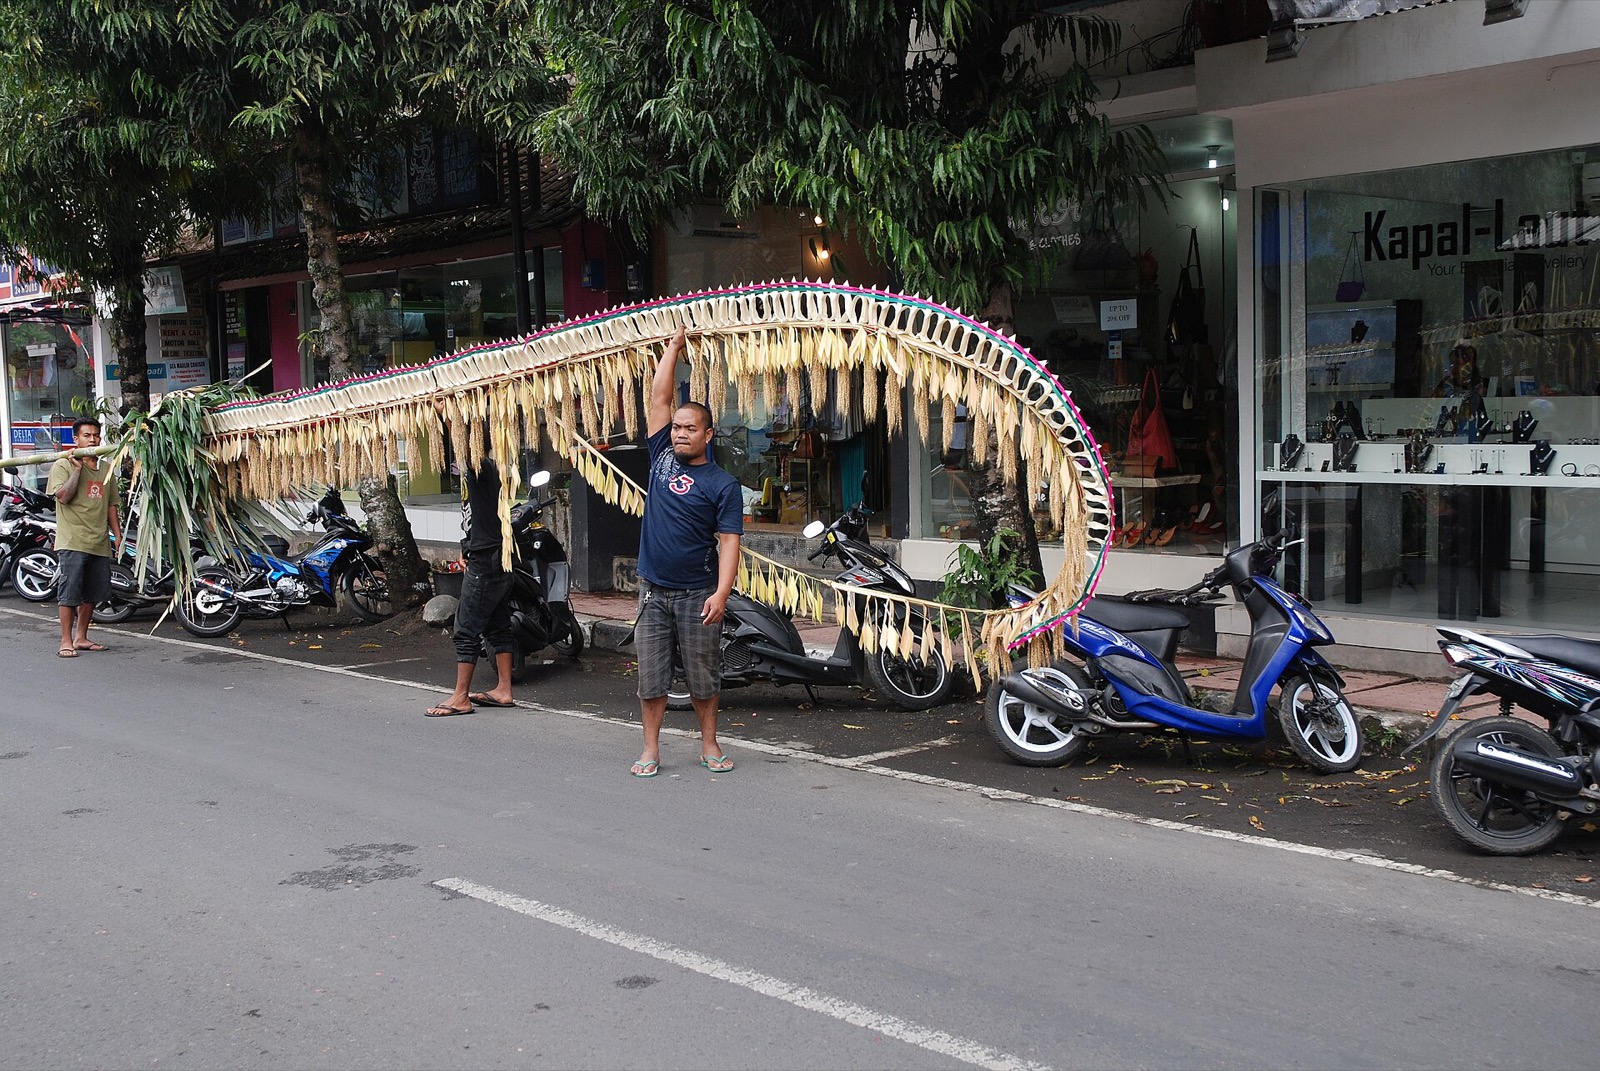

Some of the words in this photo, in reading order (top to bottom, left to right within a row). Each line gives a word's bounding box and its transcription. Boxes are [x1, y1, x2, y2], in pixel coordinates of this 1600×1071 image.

[1427, 263, 1457, 276] Your
[1118, 304, 1128, 312] TO
[1118, 314, 1131, 322] OFF
[164, 339, 185, 347] MOTOR
[13, 429, 33, 439] DELTA
